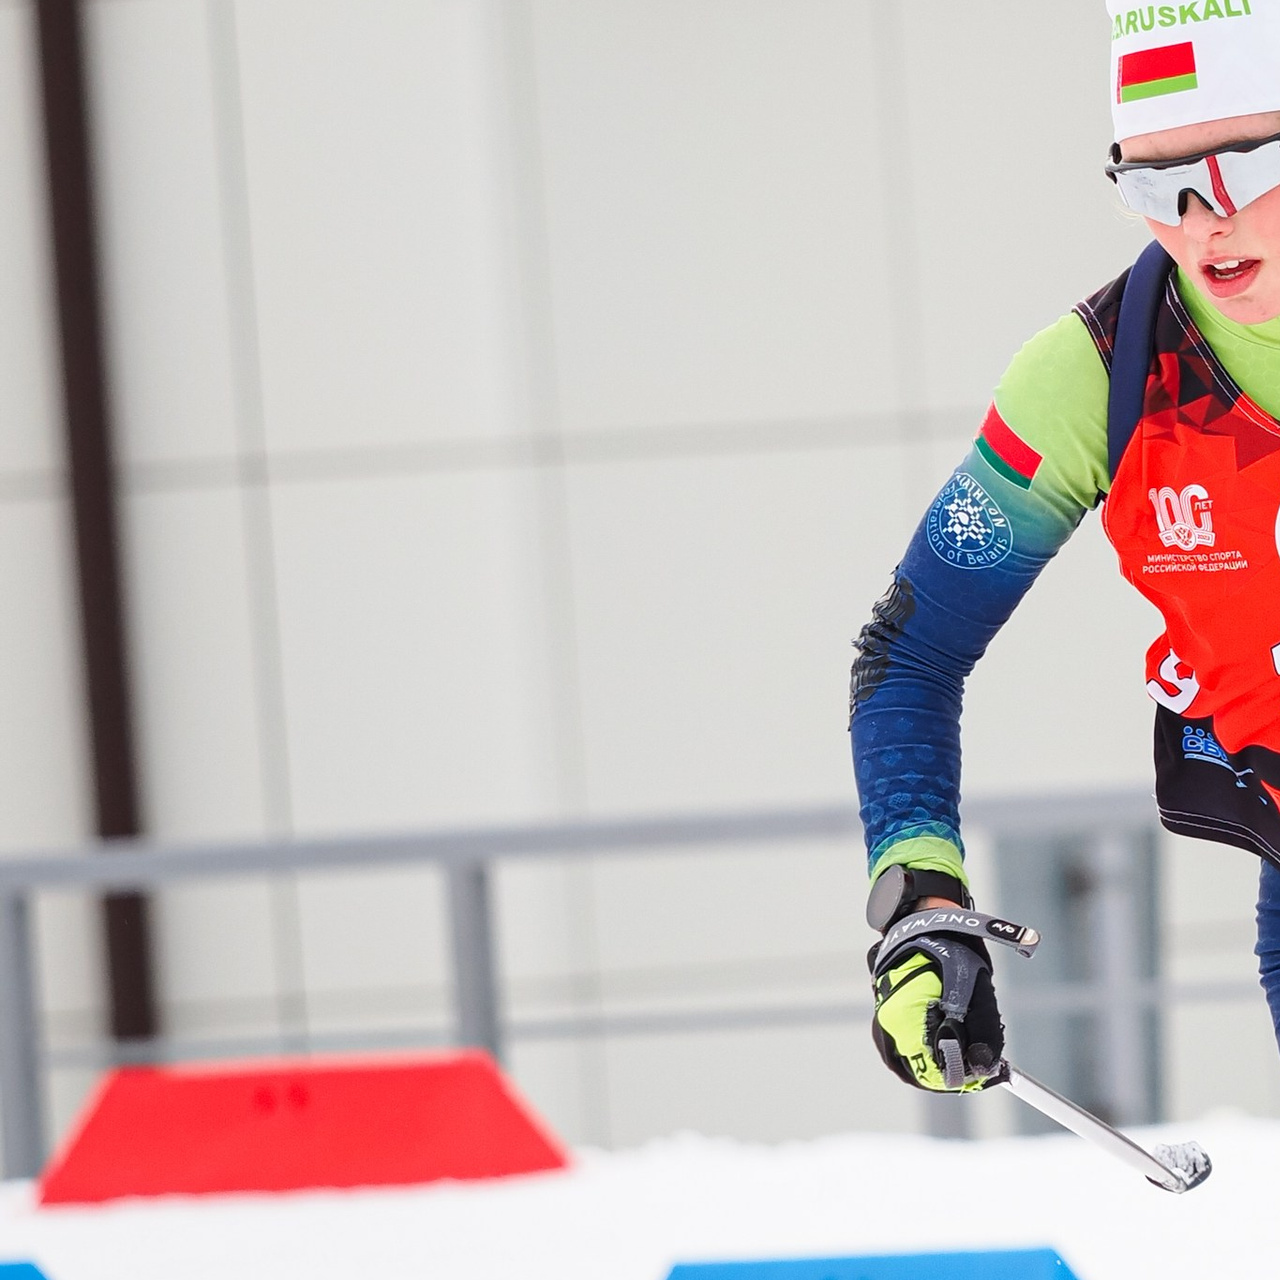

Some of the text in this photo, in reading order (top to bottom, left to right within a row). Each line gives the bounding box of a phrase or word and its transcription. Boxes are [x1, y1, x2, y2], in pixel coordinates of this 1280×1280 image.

[1194, 500, 1213, 511] ЛЕТ
[947, 550, 962, 562] of
[1147, 550, 1242, 563] МИНИСТЕРСТВО СПОРТА
[1142, 560, 1248, 574] РОССИЙСКОЙ ФЕДЕРАЦИИ
[890, 912, 979, 943] ONE/WAY
